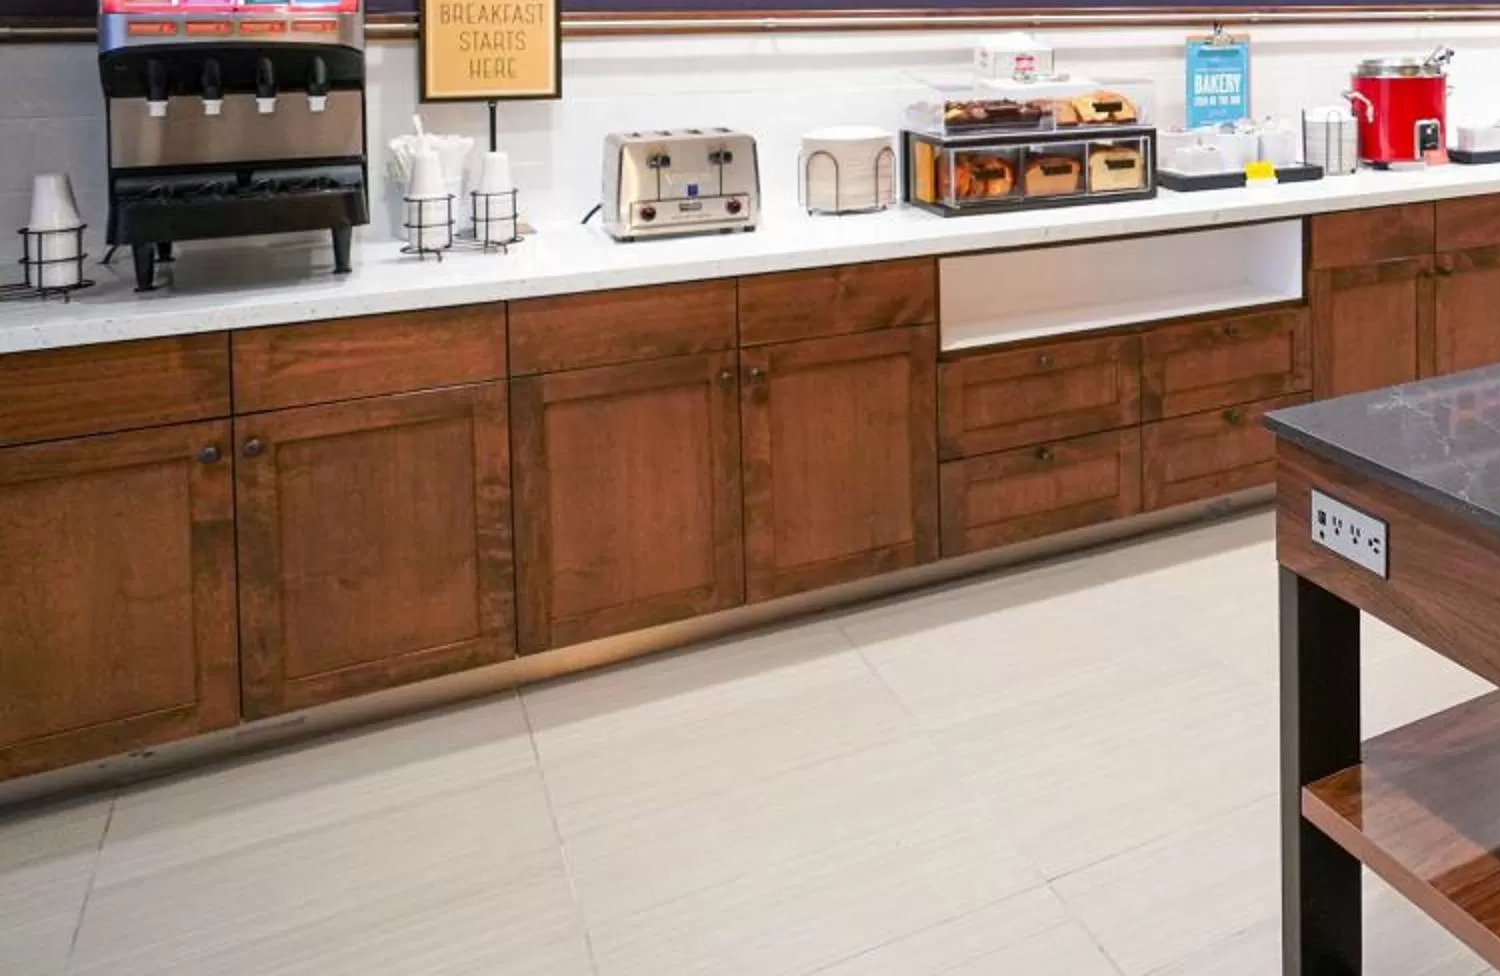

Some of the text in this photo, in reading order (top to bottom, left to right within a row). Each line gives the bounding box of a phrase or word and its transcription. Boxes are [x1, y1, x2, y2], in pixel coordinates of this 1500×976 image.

[440, 3, 544, 26] BREAKFAST
[459, 30, 527, 52] STARTS
[468, 58, 518, 79] HERE
[1194, 73, 1242, 94] BAKERY
